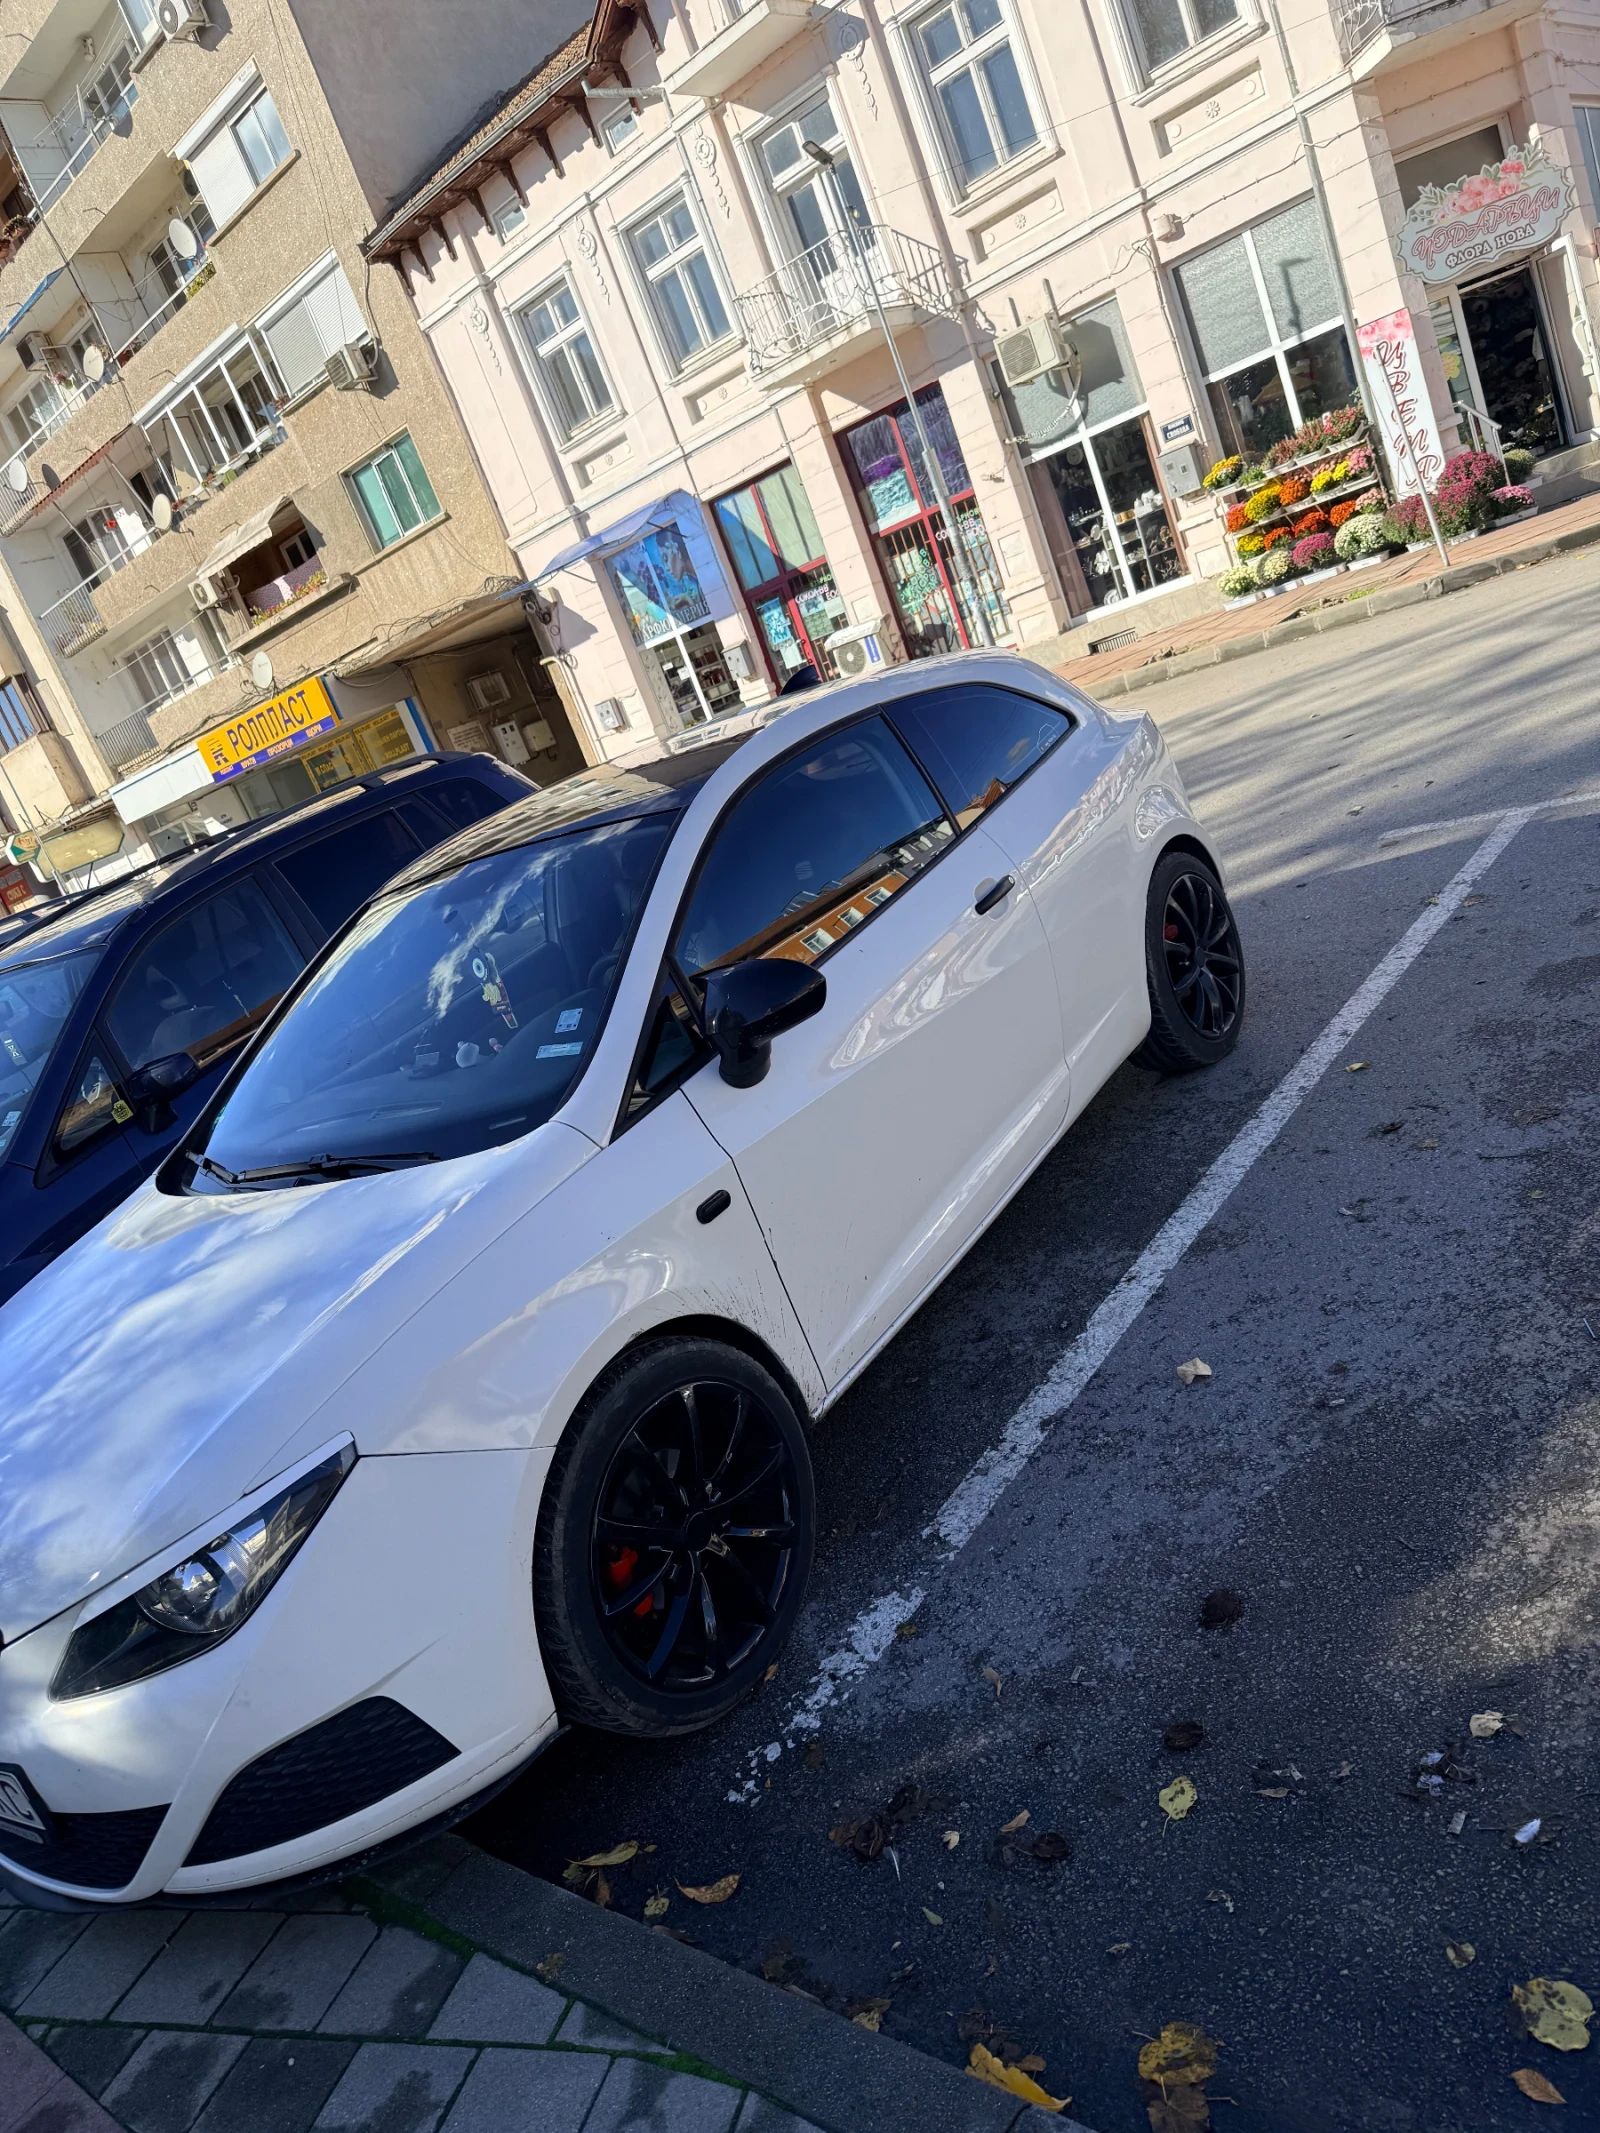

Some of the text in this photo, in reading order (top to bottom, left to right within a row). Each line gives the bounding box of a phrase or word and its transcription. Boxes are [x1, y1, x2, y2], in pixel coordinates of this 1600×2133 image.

[1446, 223, 1535, 269] ФЛОРА НОВА
[227, 689, 313, 757] РОЛПЛАСТ
